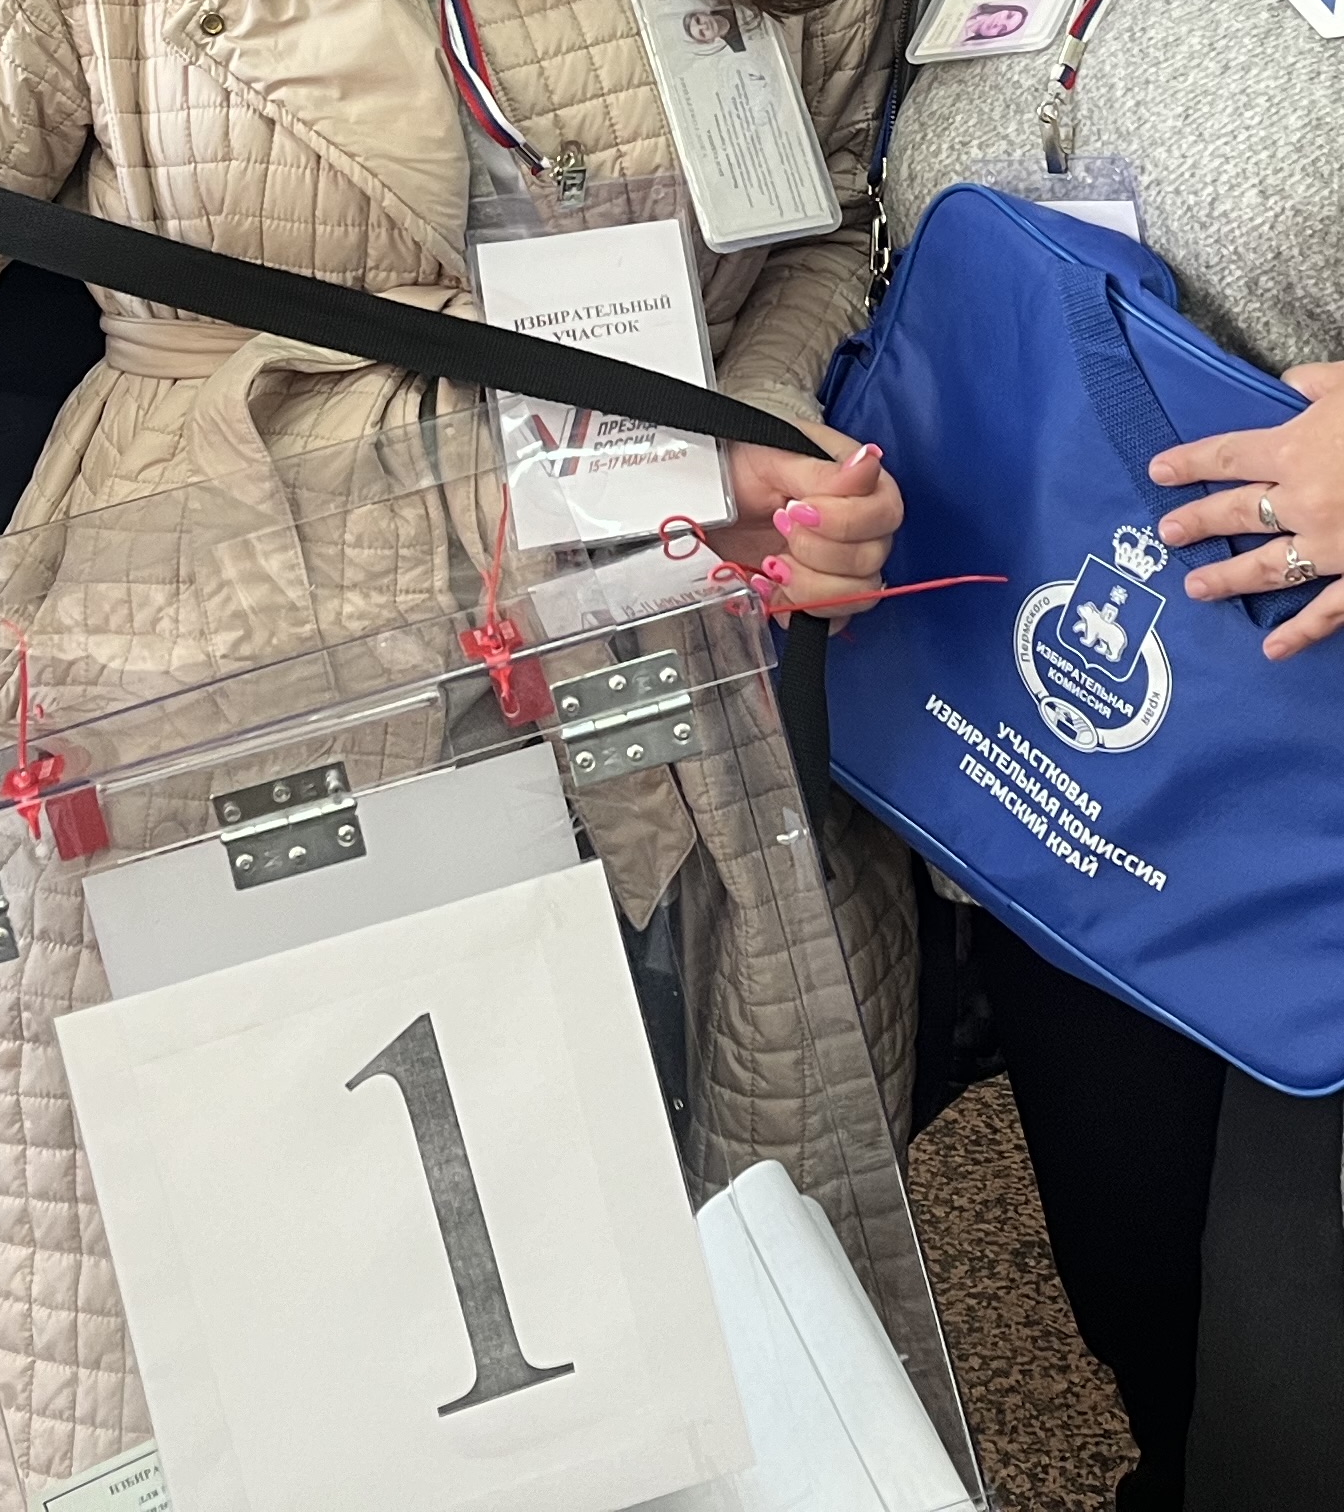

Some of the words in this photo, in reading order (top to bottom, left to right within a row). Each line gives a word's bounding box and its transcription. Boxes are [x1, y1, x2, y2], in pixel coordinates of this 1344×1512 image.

[513, 294, 672, 333] ИЗБИРАТЕЛЬНЫЙ
[552, 320, 640, 342] УЧАСТОК
[1020, 596, 1051, 664] Пермского
[1035, 640, 1135, 718] ИЗБИРАТЕЛЬНАЯ
[1047, 666, 1113, 719] КОМИССИЯ
[1140, 691, 1161, 726] края
[924, 693, 1062, 815] ИЗБИРАТЕЛЬНАЯ
[1057, 807, 1168, 893] КОМИССИЯ
[997, 721, 1103, 822] УЧАСТКОВАЯ
[958, 752, 1049, 841] ПЕРМСКИЙ
[1044, 835, 1100, 879] КРАЙ
[343, 1012, 576, 1419] 1
